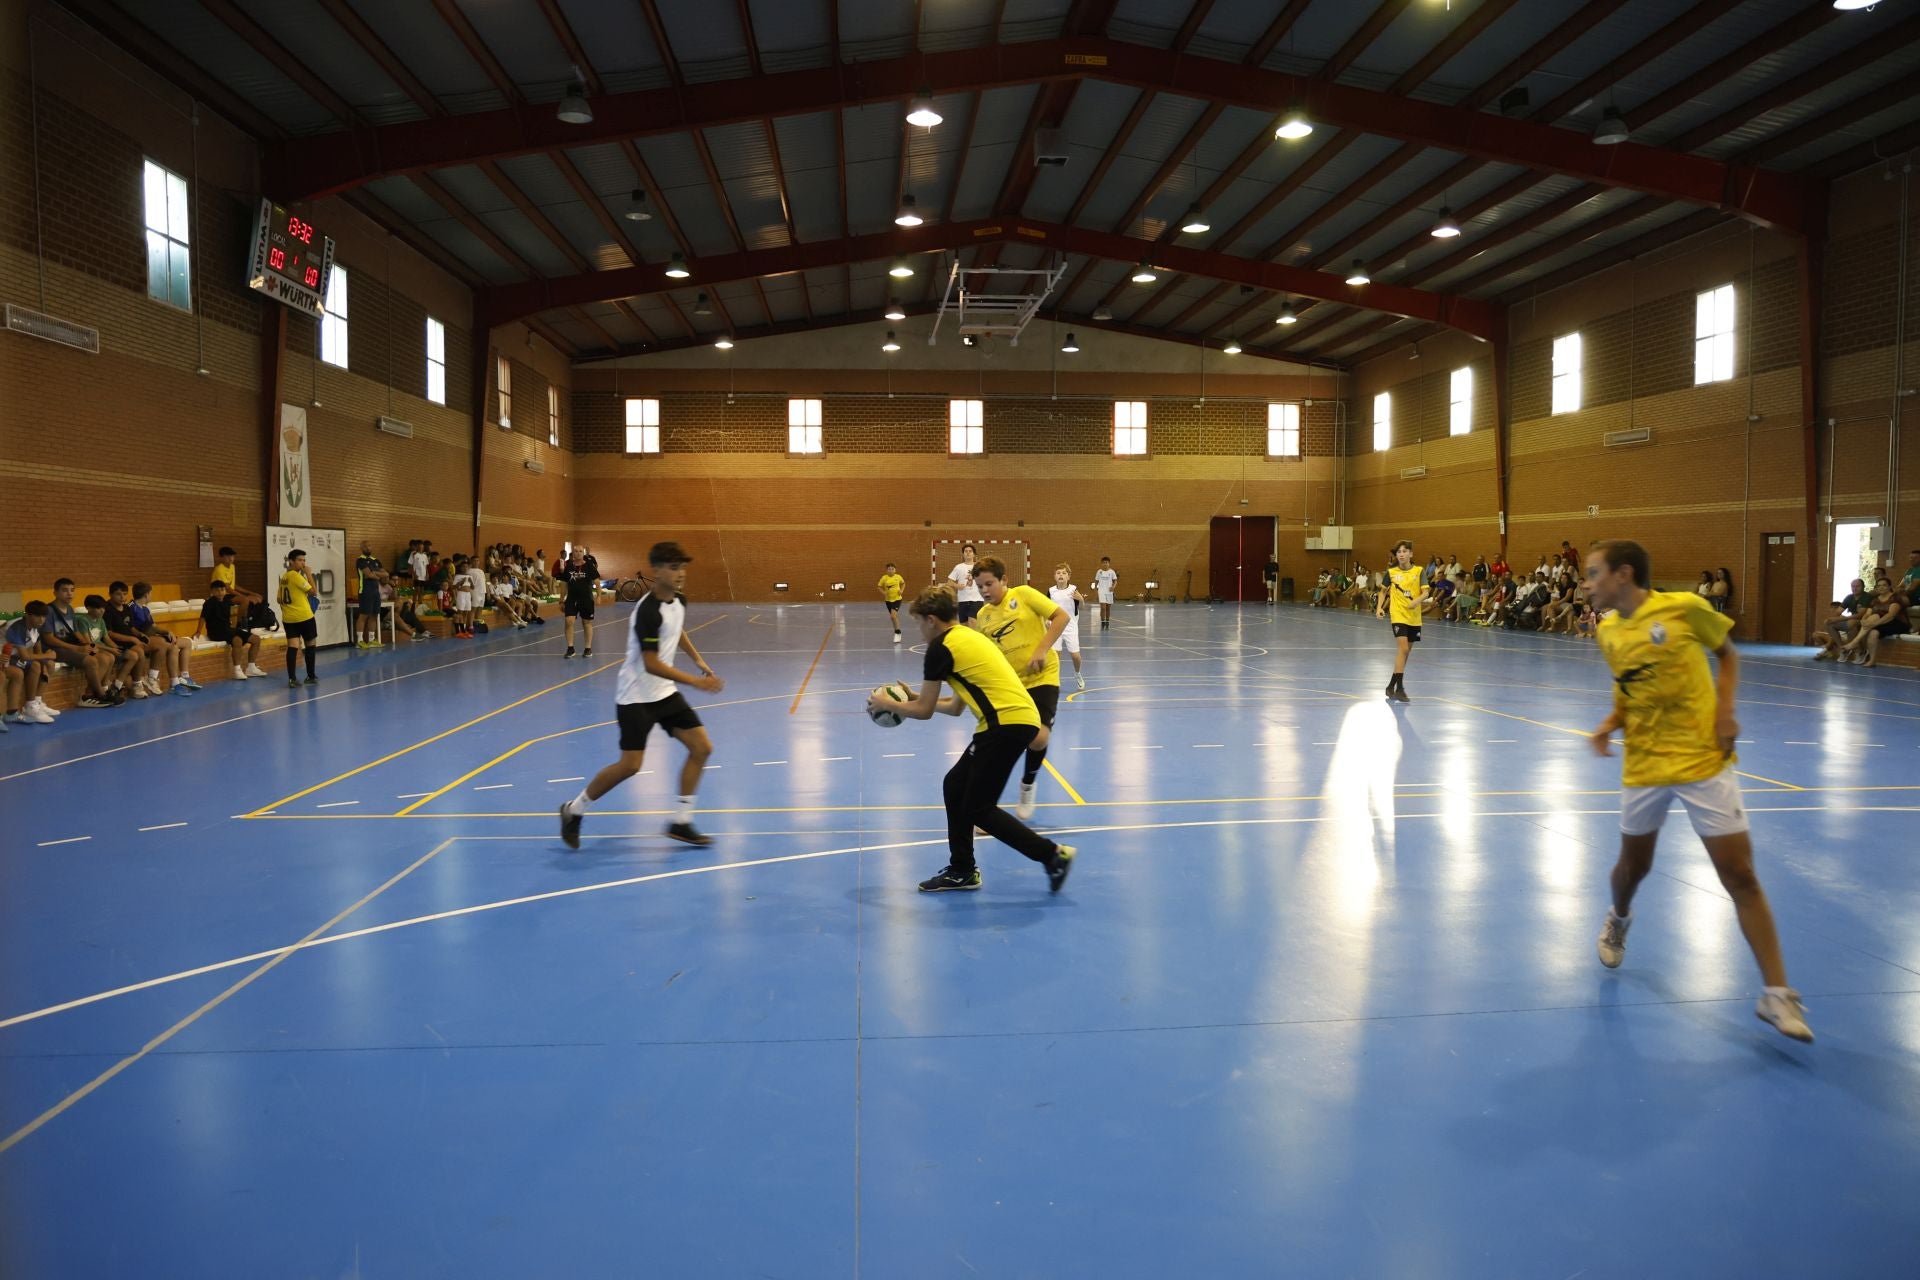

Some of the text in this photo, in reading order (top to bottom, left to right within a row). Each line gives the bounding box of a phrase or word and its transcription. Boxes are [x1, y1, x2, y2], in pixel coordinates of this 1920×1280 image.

[288, 216, 312, 244] 13:32
[270, 248, 285, 270] 00
[305, 266, 319, 287] 00
[279, 280, 318, 313] WÜRTH
